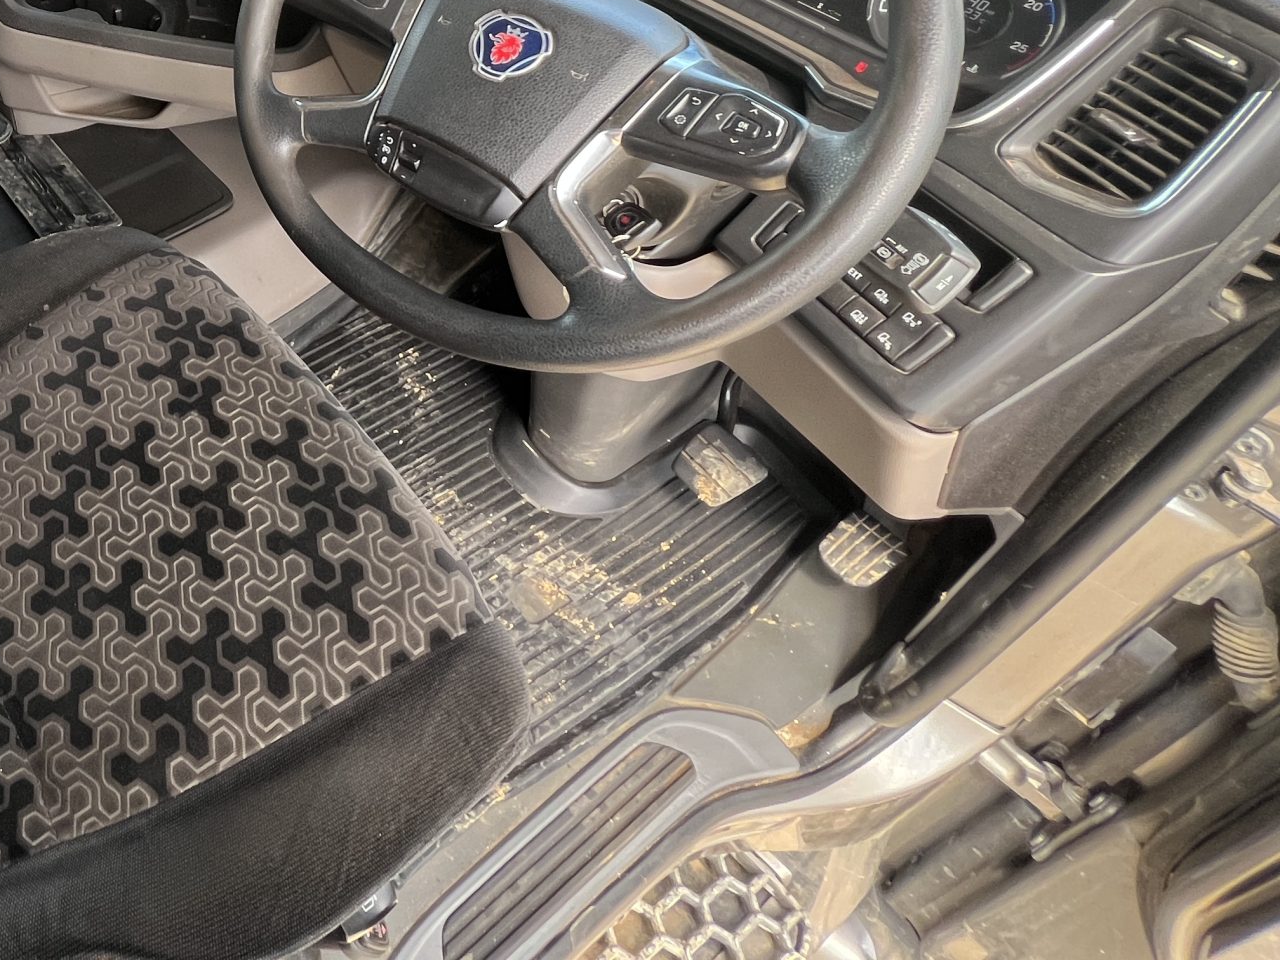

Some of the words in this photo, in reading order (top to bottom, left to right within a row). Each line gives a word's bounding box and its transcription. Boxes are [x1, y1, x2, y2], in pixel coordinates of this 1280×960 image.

[1023, 0, 1043, 12] 20
[1009, 41, 1029, 54] 25
[737, 121, 750, 130] OK
[847, 267, 863, 280] EXT
